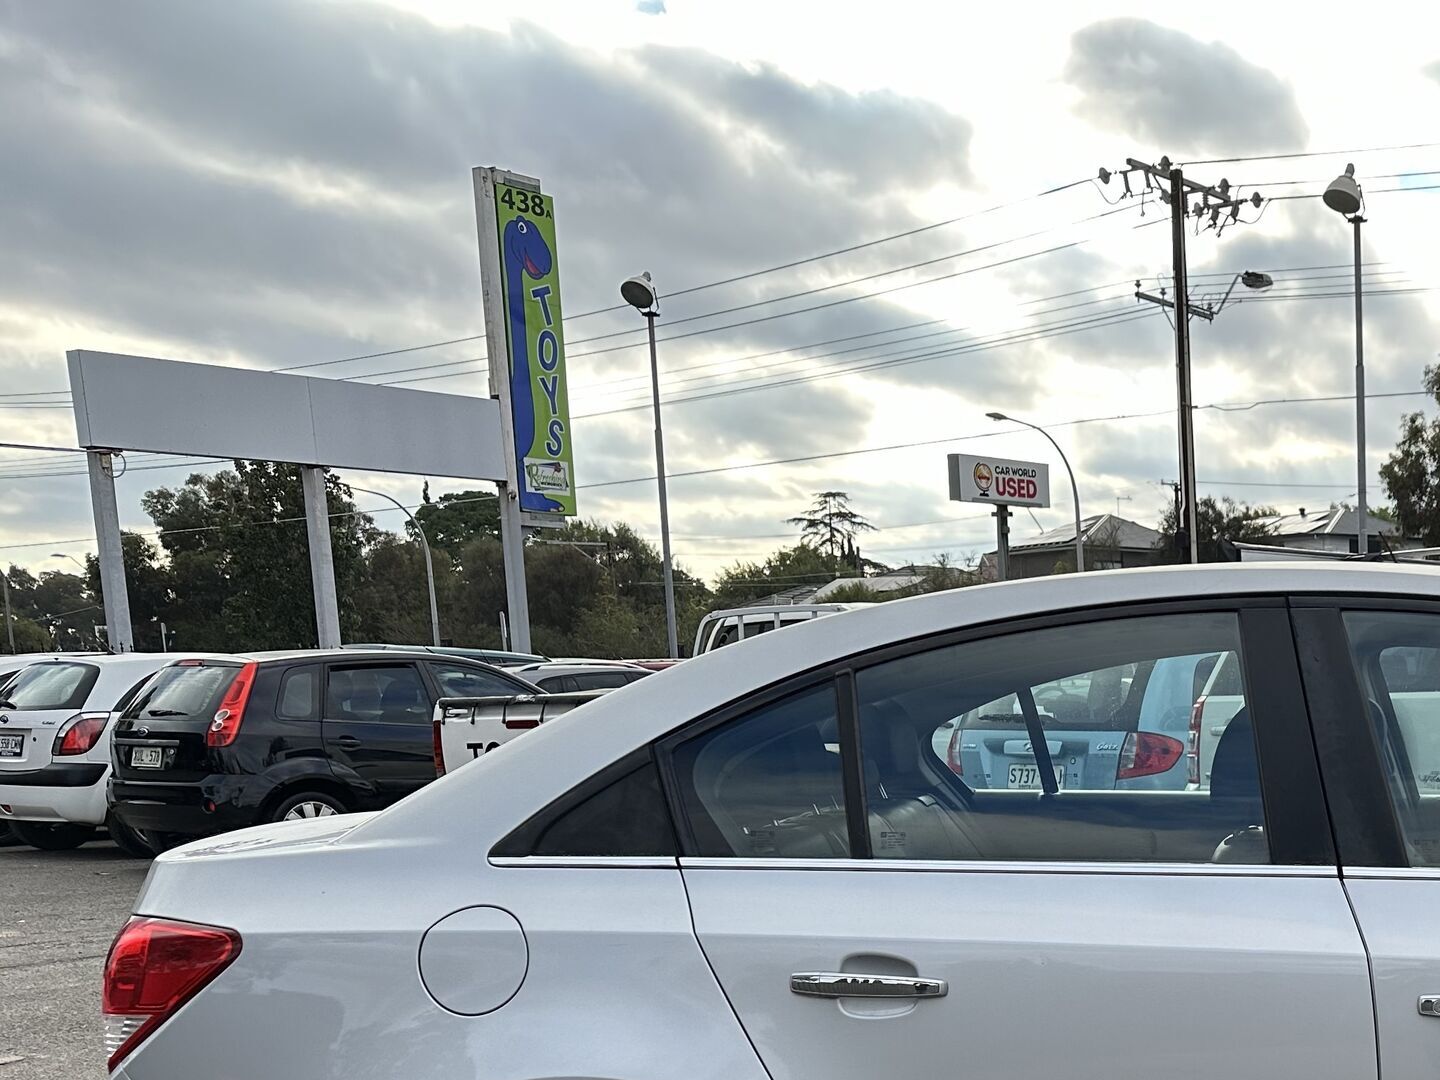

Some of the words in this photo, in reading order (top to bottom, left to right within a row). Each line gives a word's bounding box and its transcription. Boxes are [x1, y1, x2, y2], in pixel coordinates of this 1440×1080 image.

[531, 286, 565, 457] TOYS
[995, 466, 1010, 475] CAR
[1011, 467, 1036, 478] WORLD
[995, 476, 1037, 498] USED
[1010, 768, 1036, 784] S737
